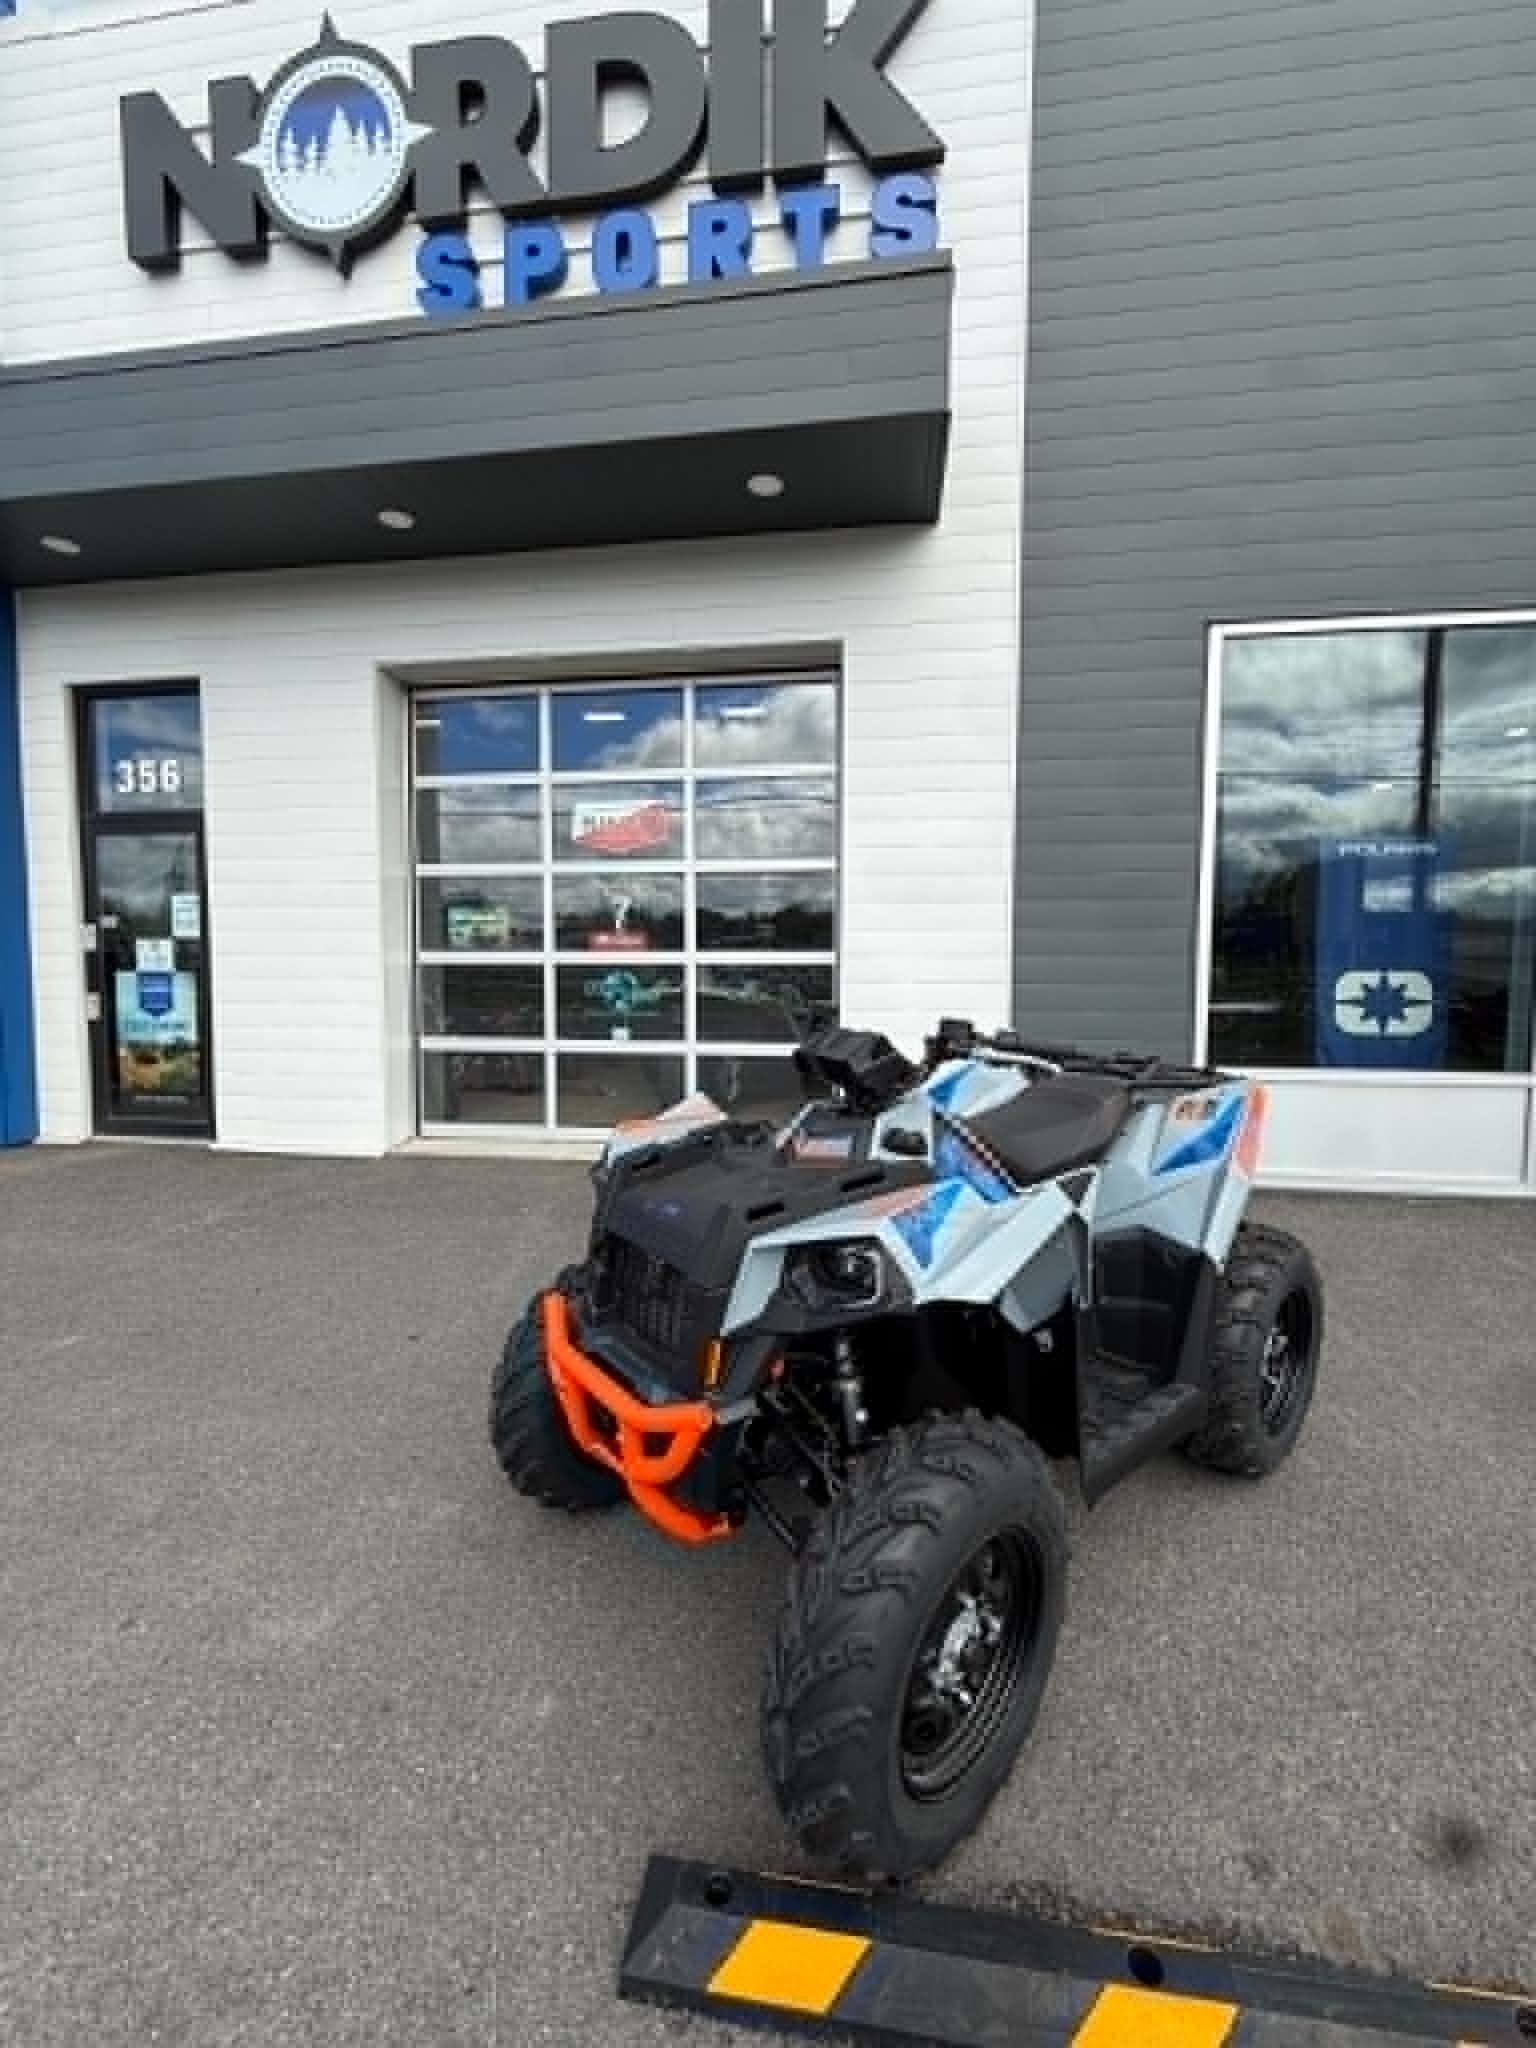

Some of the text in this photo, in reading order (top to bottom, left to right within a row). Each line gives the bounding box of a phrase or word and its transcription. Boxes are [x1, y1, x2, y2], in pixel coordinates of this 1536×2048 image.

[119, 0, 946, 277] NORDIK
[415, 173, 938, 320] SPORTS
[115, 758, 182, 795] 356
